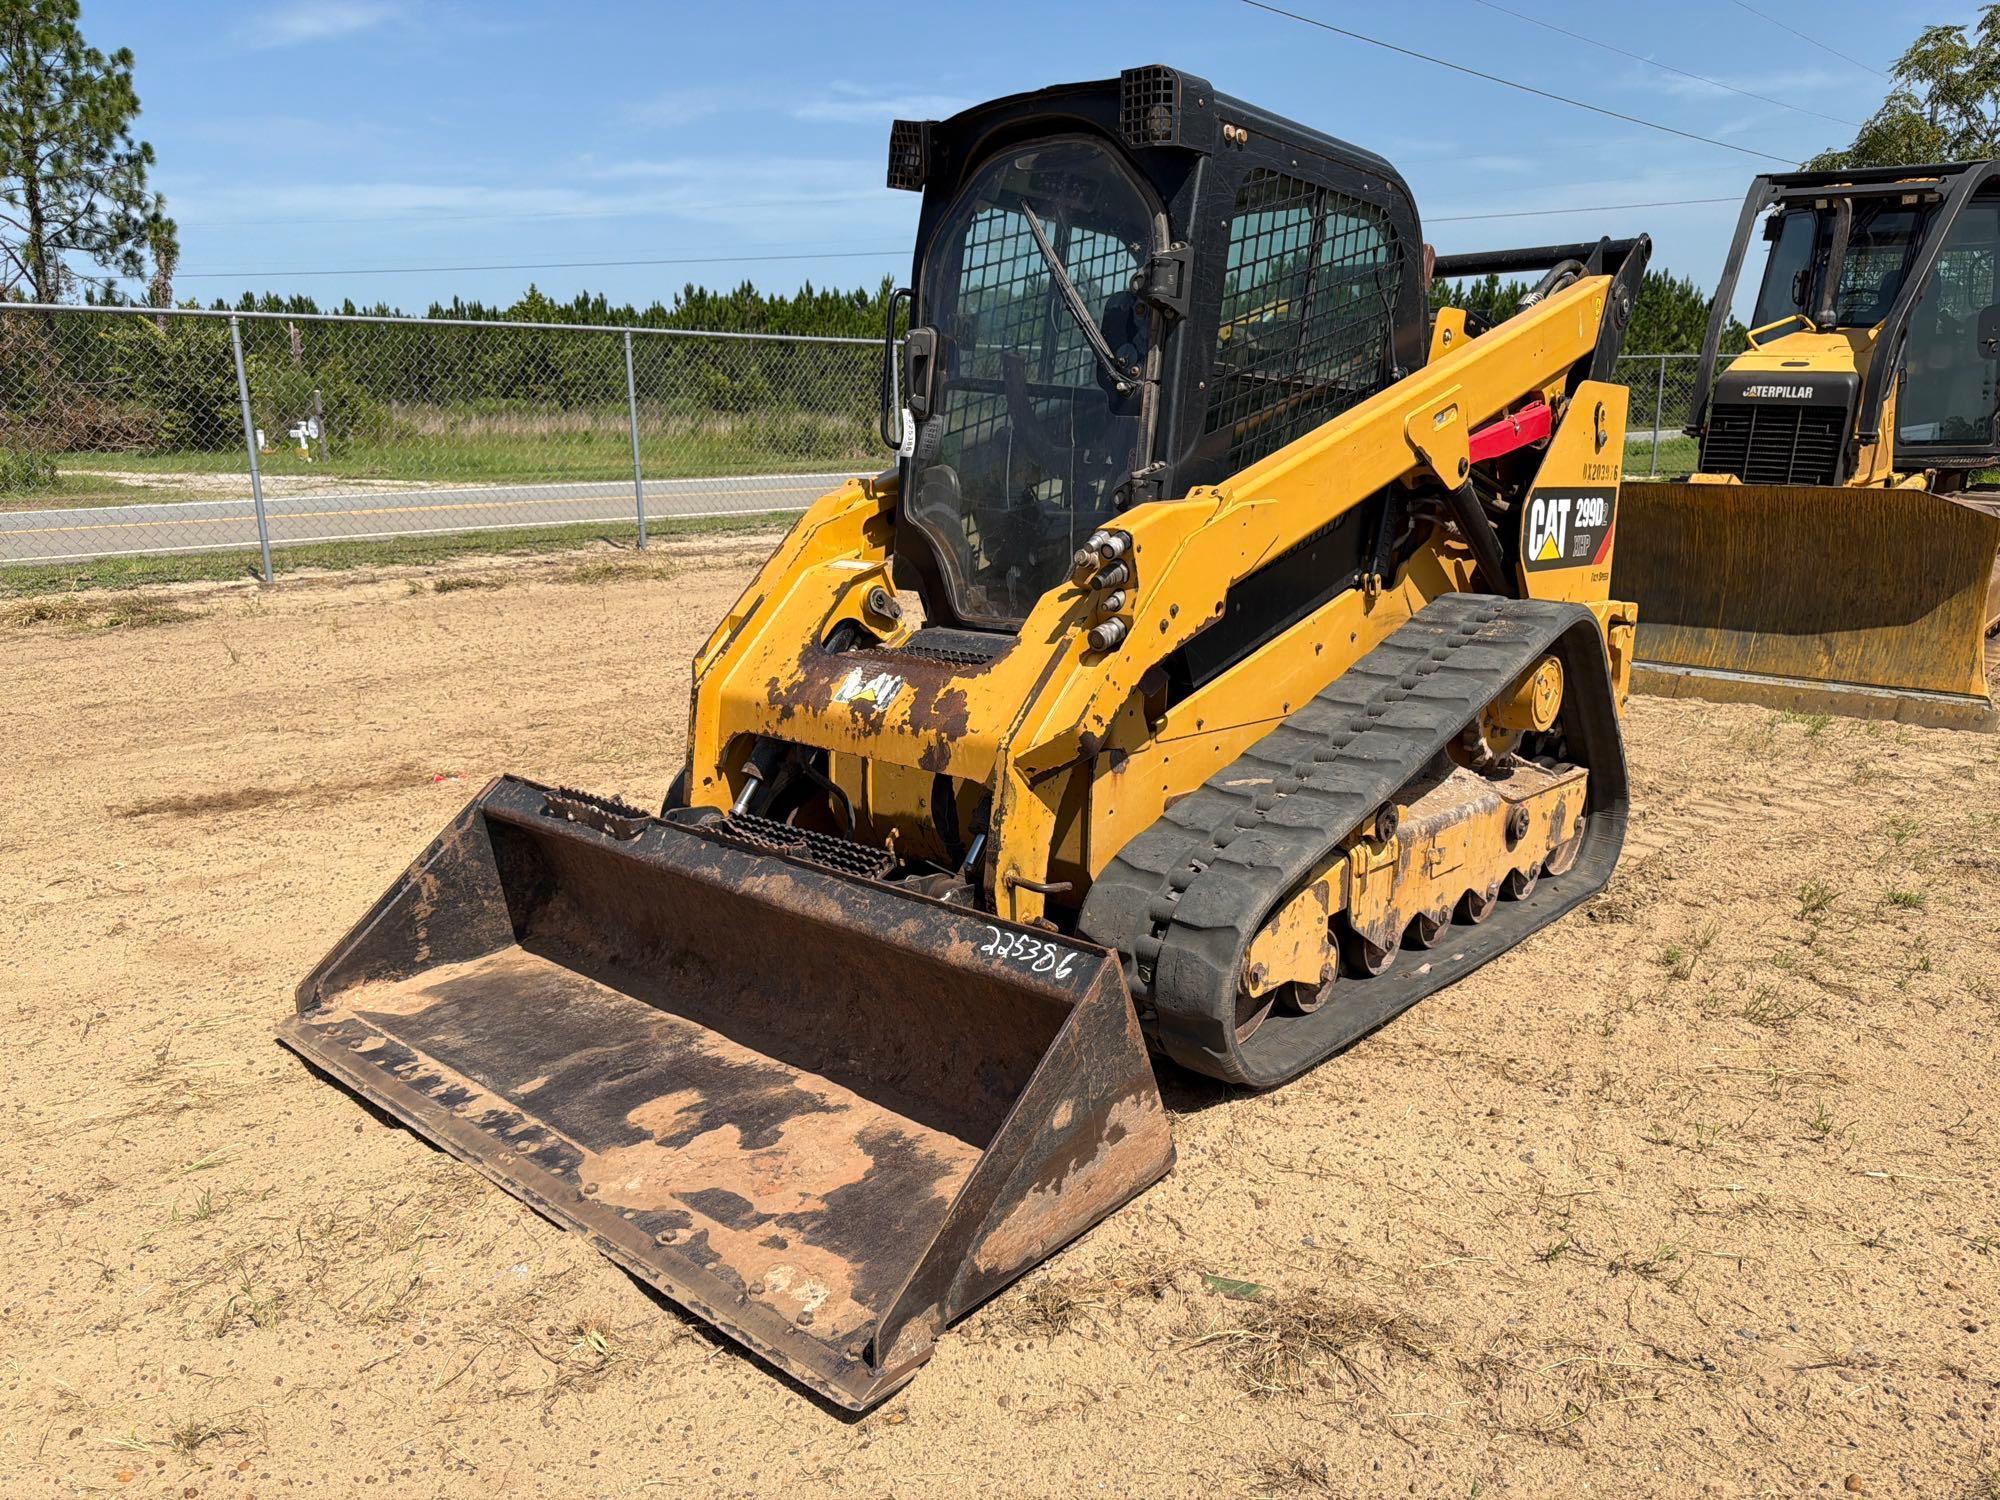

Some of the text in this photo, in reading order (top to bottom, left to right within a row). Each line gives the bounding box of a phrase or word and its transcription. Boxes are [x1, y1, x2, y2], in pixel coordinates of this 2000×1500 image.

[1742, 385, 1813, 398] CATERPILLAR
[1528, 498, 1571, 561] CAT
[981, 925, 1078, 979] 225386
